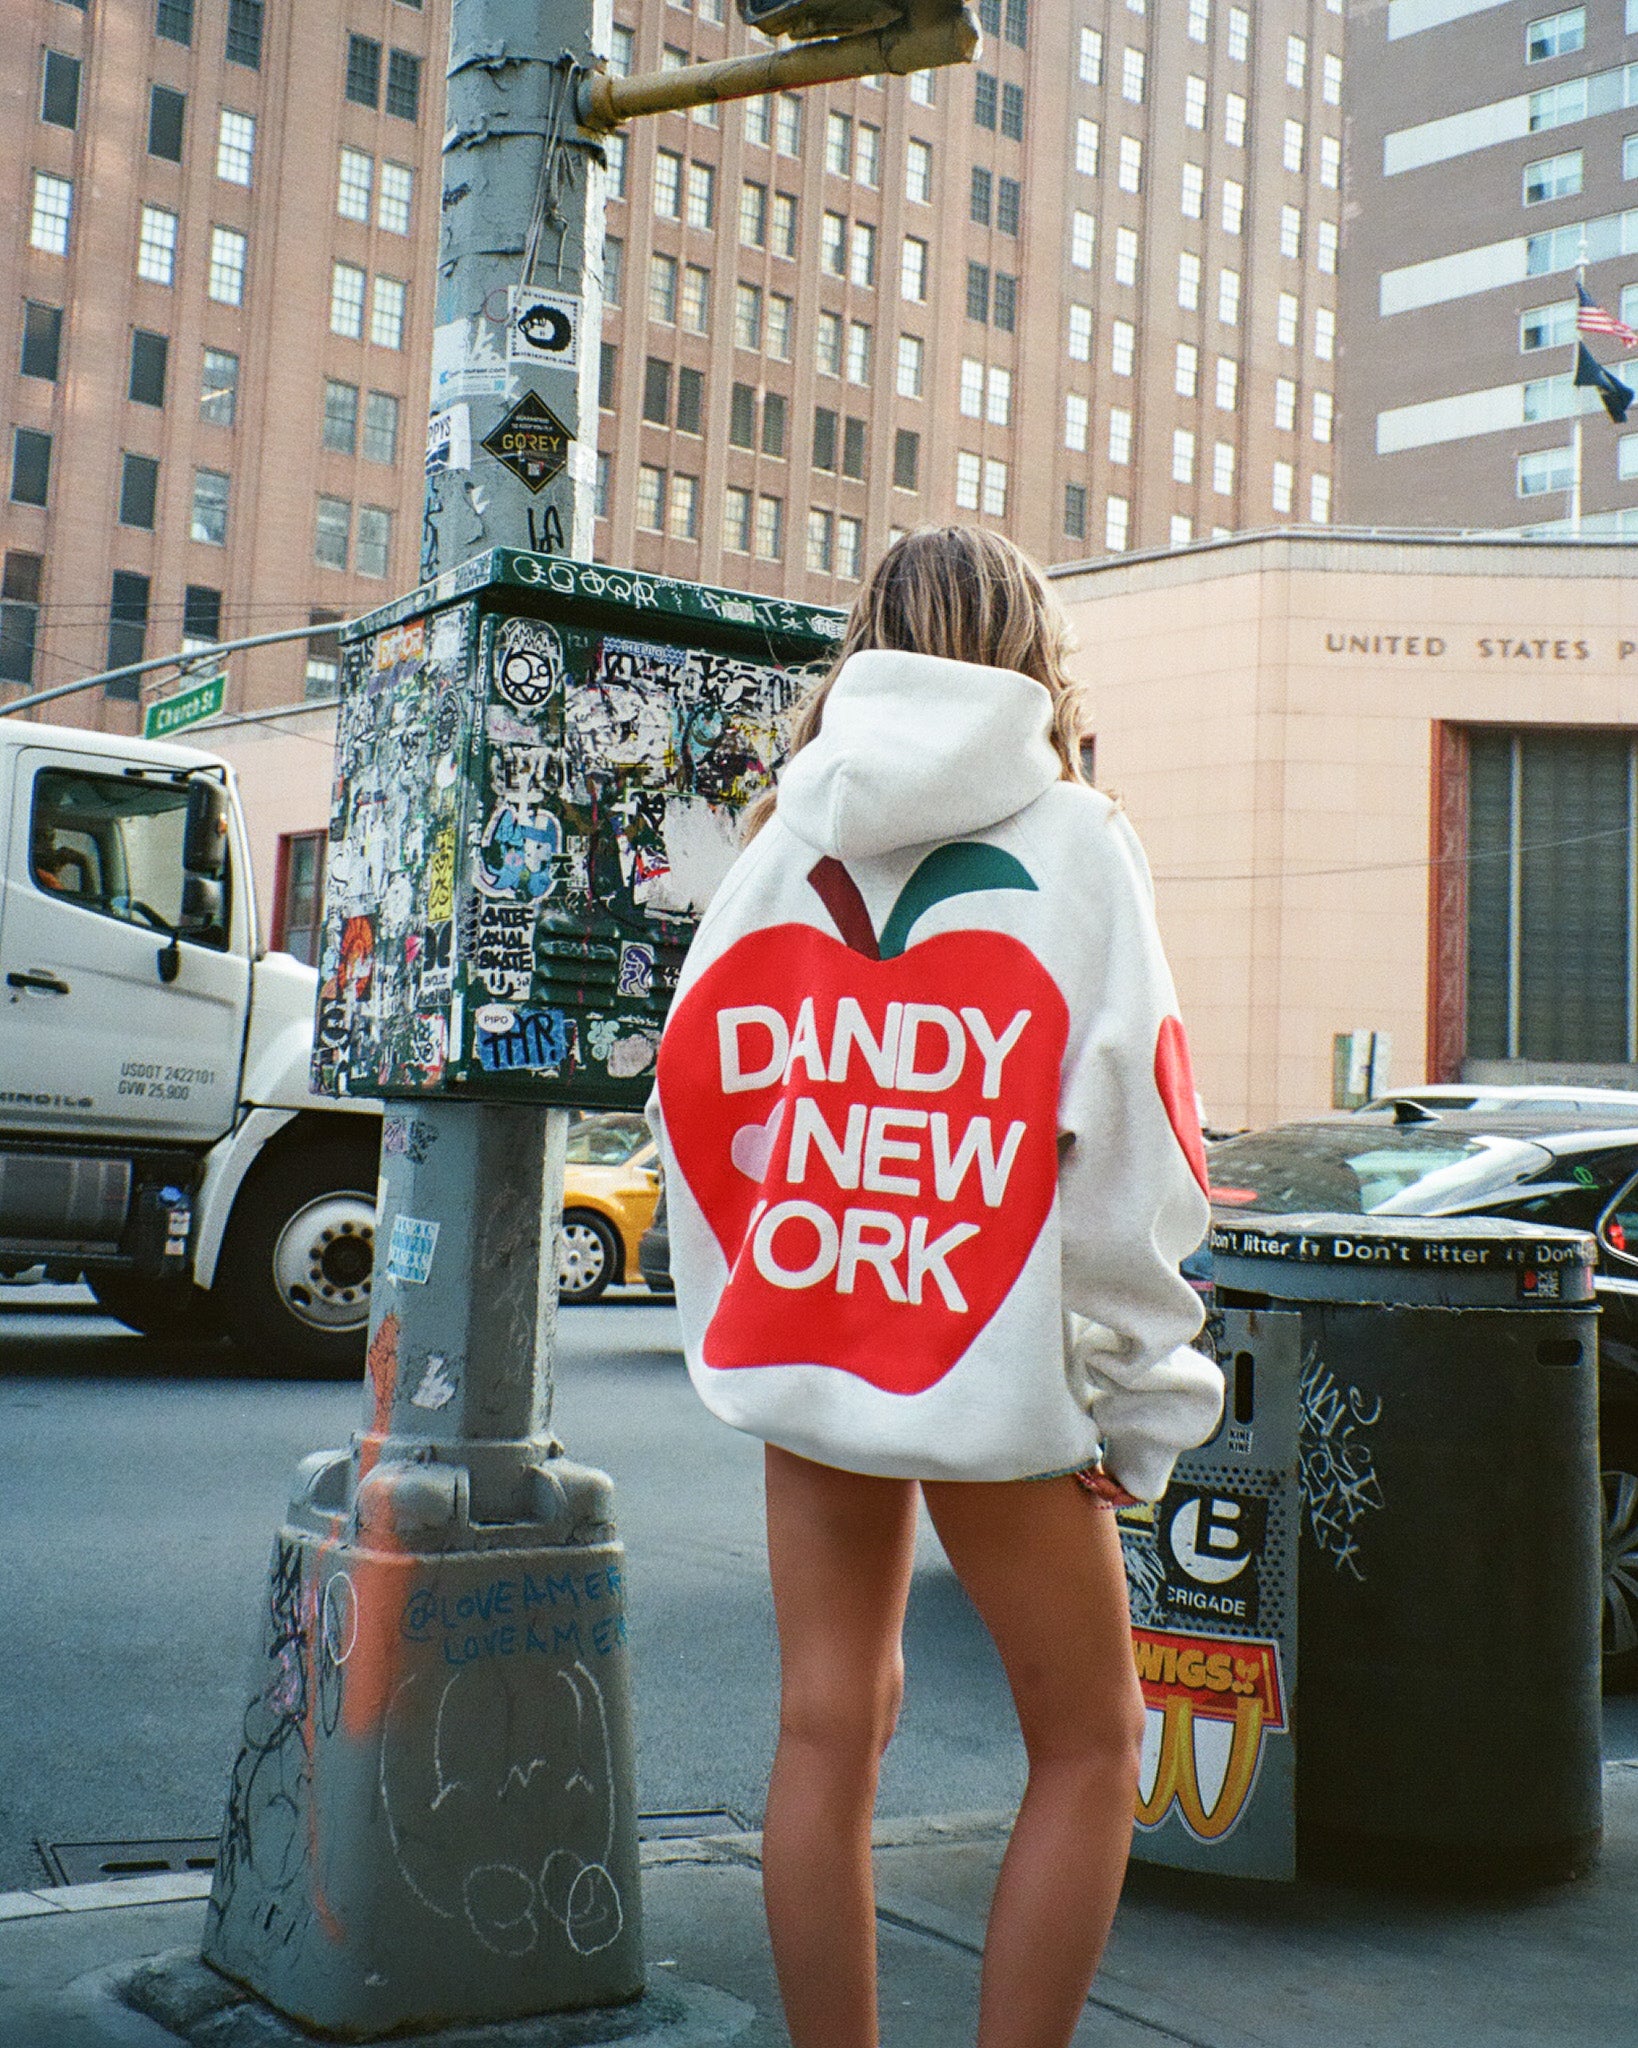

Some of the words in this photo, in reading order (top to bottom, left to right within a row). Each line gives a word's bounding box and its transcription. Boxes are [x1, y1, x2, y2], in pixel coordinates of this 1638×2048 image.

[502, 433, 560, 451] GOREY
[1325, 634, 1447, 656] UNITED
[1477, 638, 1590, 659] STATES
[716, 997, 1032, 1100] DANDY
[121, 1062, 161, 1079] USDOT
[118, 1080, 146, 1096] GVW
[787, 1097, 1027, 1208] NEW
[729, 1199, 981, 1313] ORK
[1334, 1239, 1410, 1261] Don't
